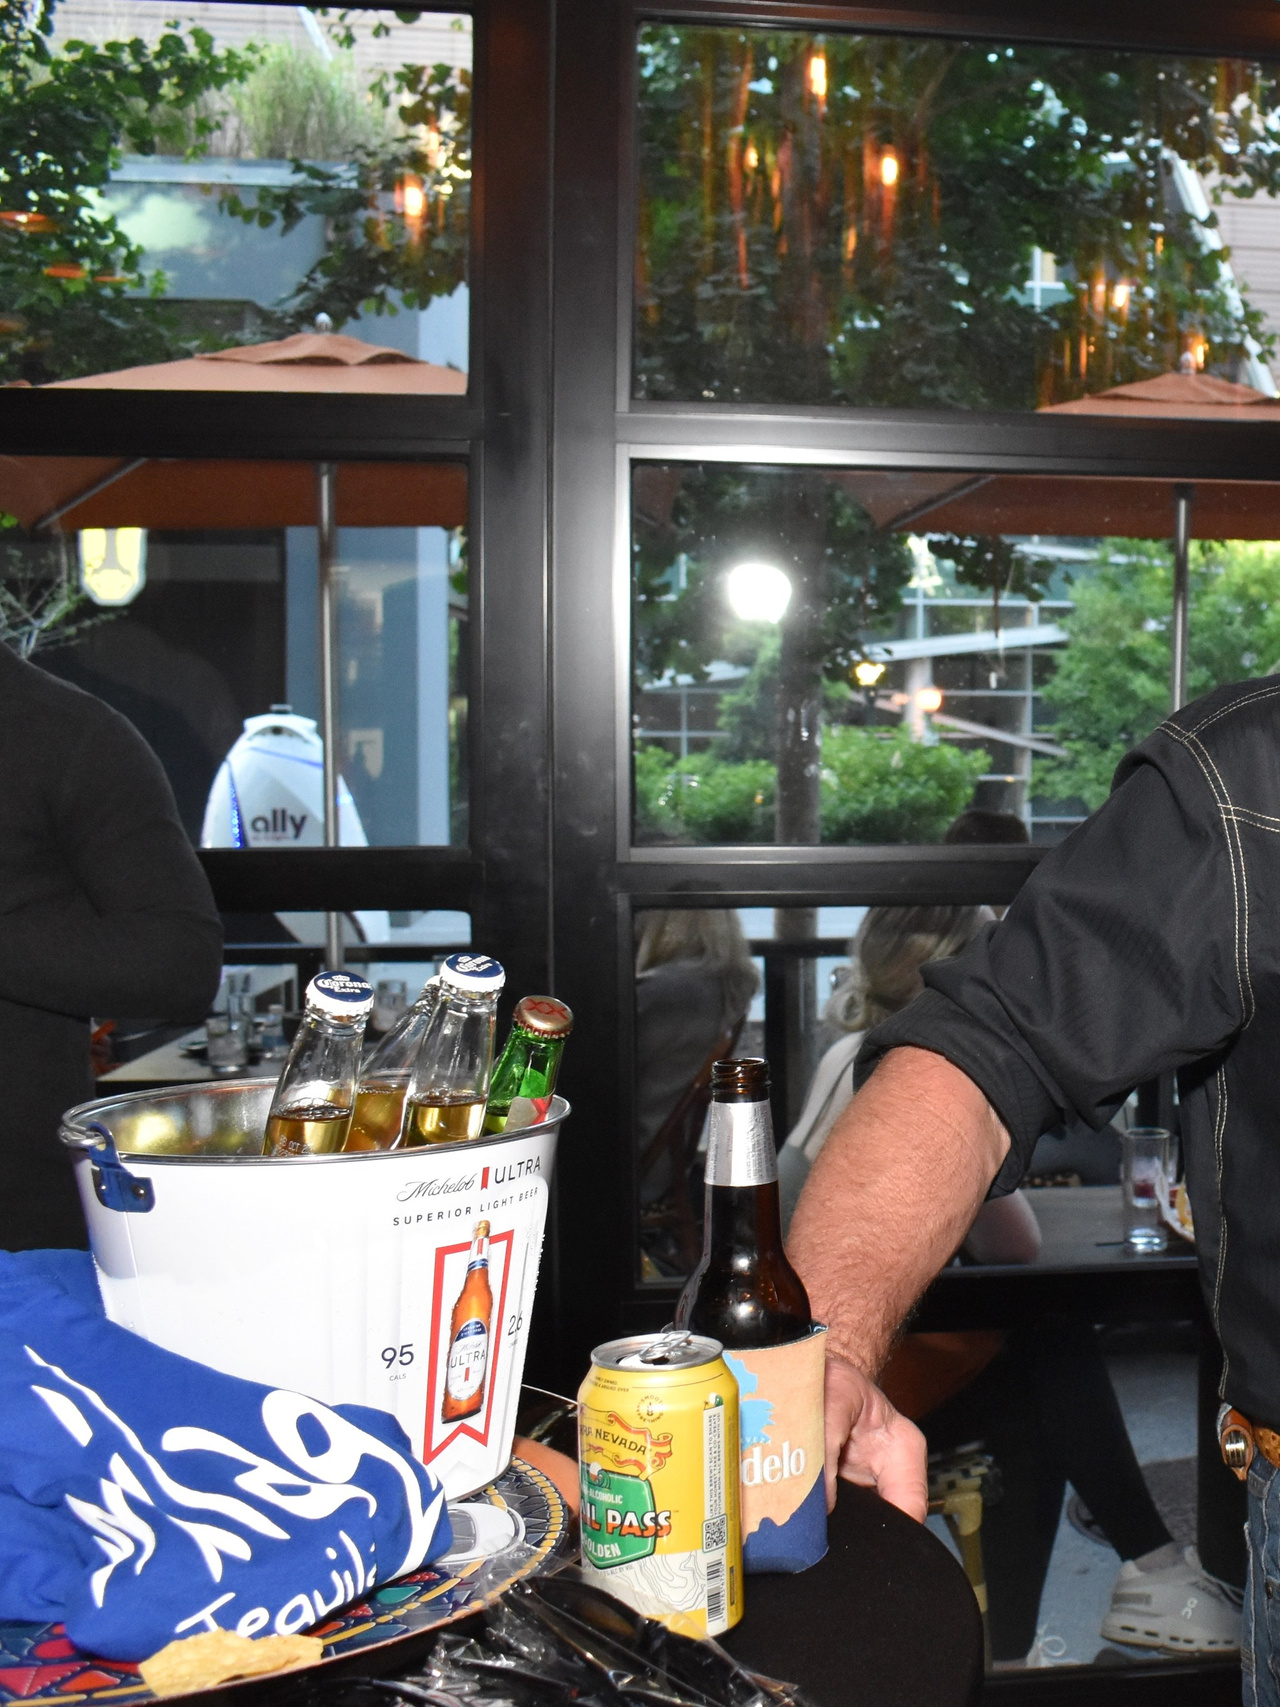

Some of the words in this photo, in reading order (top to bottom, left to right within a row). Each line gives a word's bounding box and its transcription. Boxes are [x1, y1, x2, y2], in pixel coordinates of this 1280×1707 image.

[251, 808, 307, 840] ally
[316, 977, 371, 990] Corona
[334, 986, 361, 994] Extra
[396, 1172, 478, 1202] Michelob
[494, 1156, 541, 1184] ULTRA
[393, 1206, 472, 1226] SUPERIOR
[479, 1195, 514, 1213] LIGHT
[518, 1186, 539, 1202] BEER
[381, 1343, 414, 1370] 95
[450, 1349, 487, 1369] ULTRA
[389, 1373, 407, 1382] CALS
[595, 1428, 647, 1456] NEVADA
[741, 1440, 806, 1487] delo
[606, 1508, 672, 1538] PASS
